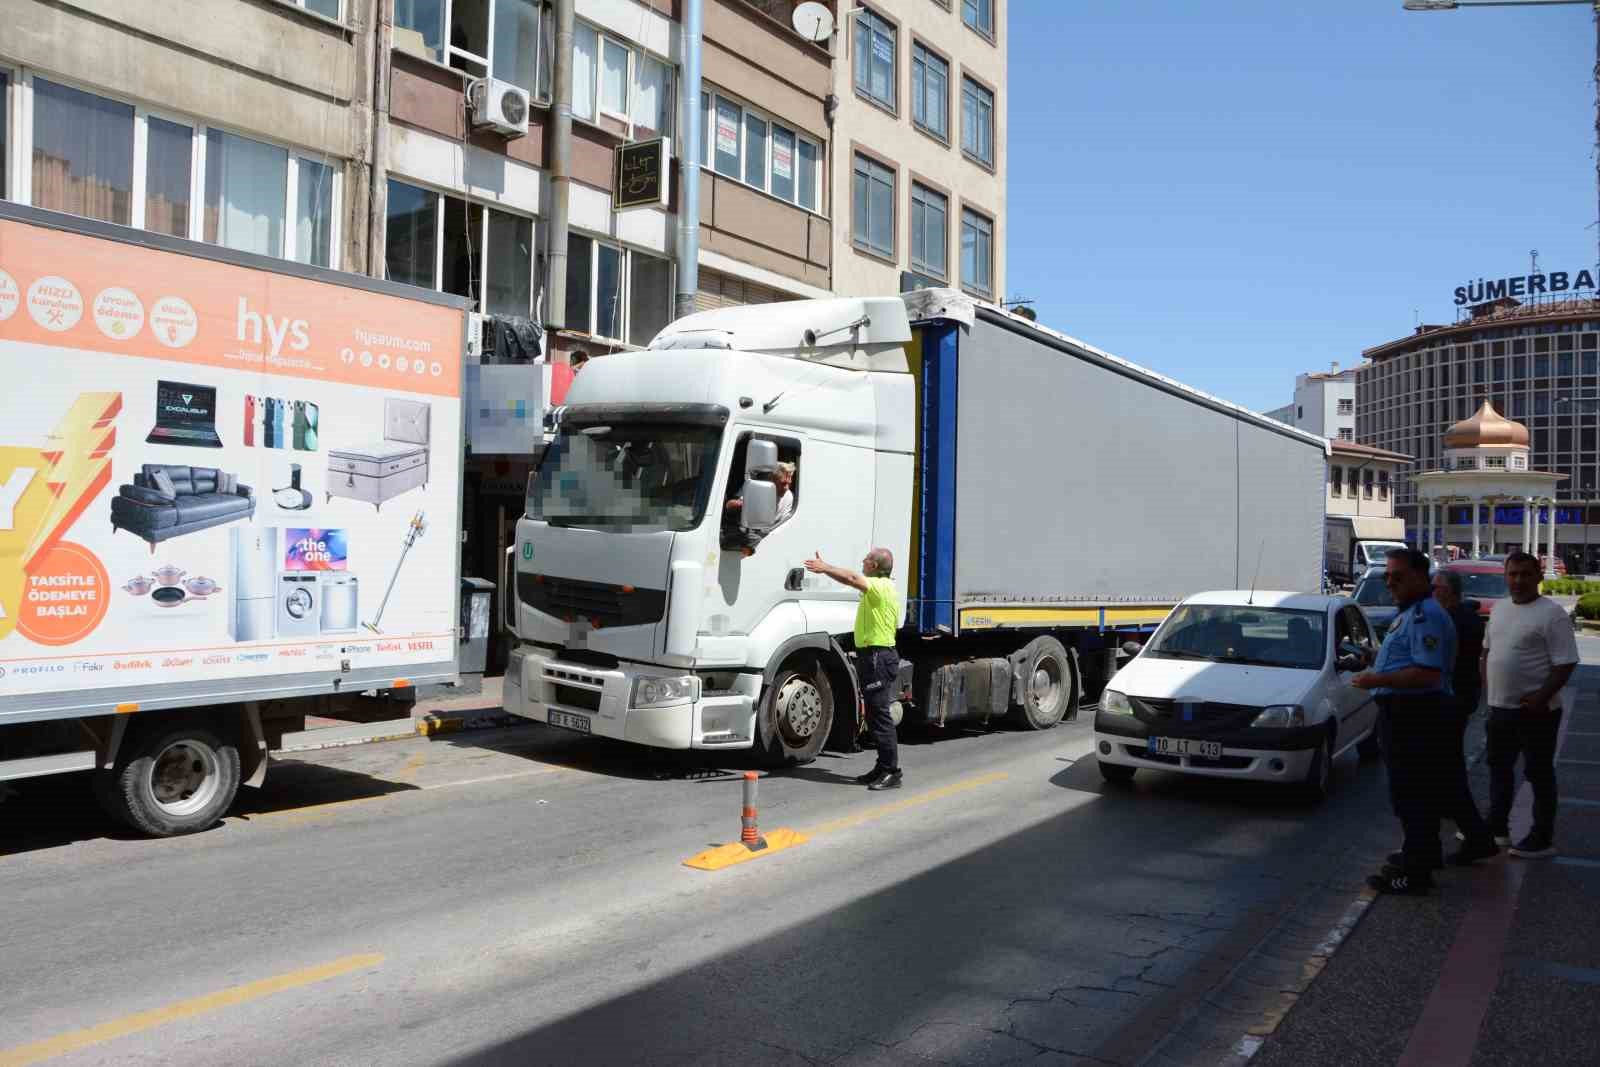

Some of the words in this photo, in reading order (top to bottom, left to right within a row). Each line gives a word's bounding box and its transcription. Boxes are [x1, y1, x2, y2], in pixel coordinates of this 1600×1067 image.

[1454, 270, 1600, 305] SÜMERBA
[236, 296, 310, 356] hys
[355, 328, 432, 353] hysavm.com
[303, 538, 326, 552] the
[305, 550, 331, 561] one
[30, 572, 96, 586] TAKSİTLE
[28, 588, 96, 602] ÖDEMEYE
[36, 605, 88, 619] BAŞLA!
[1158, 738, 1168, 752] 10
[1177, 740, 1189, 753] LT
